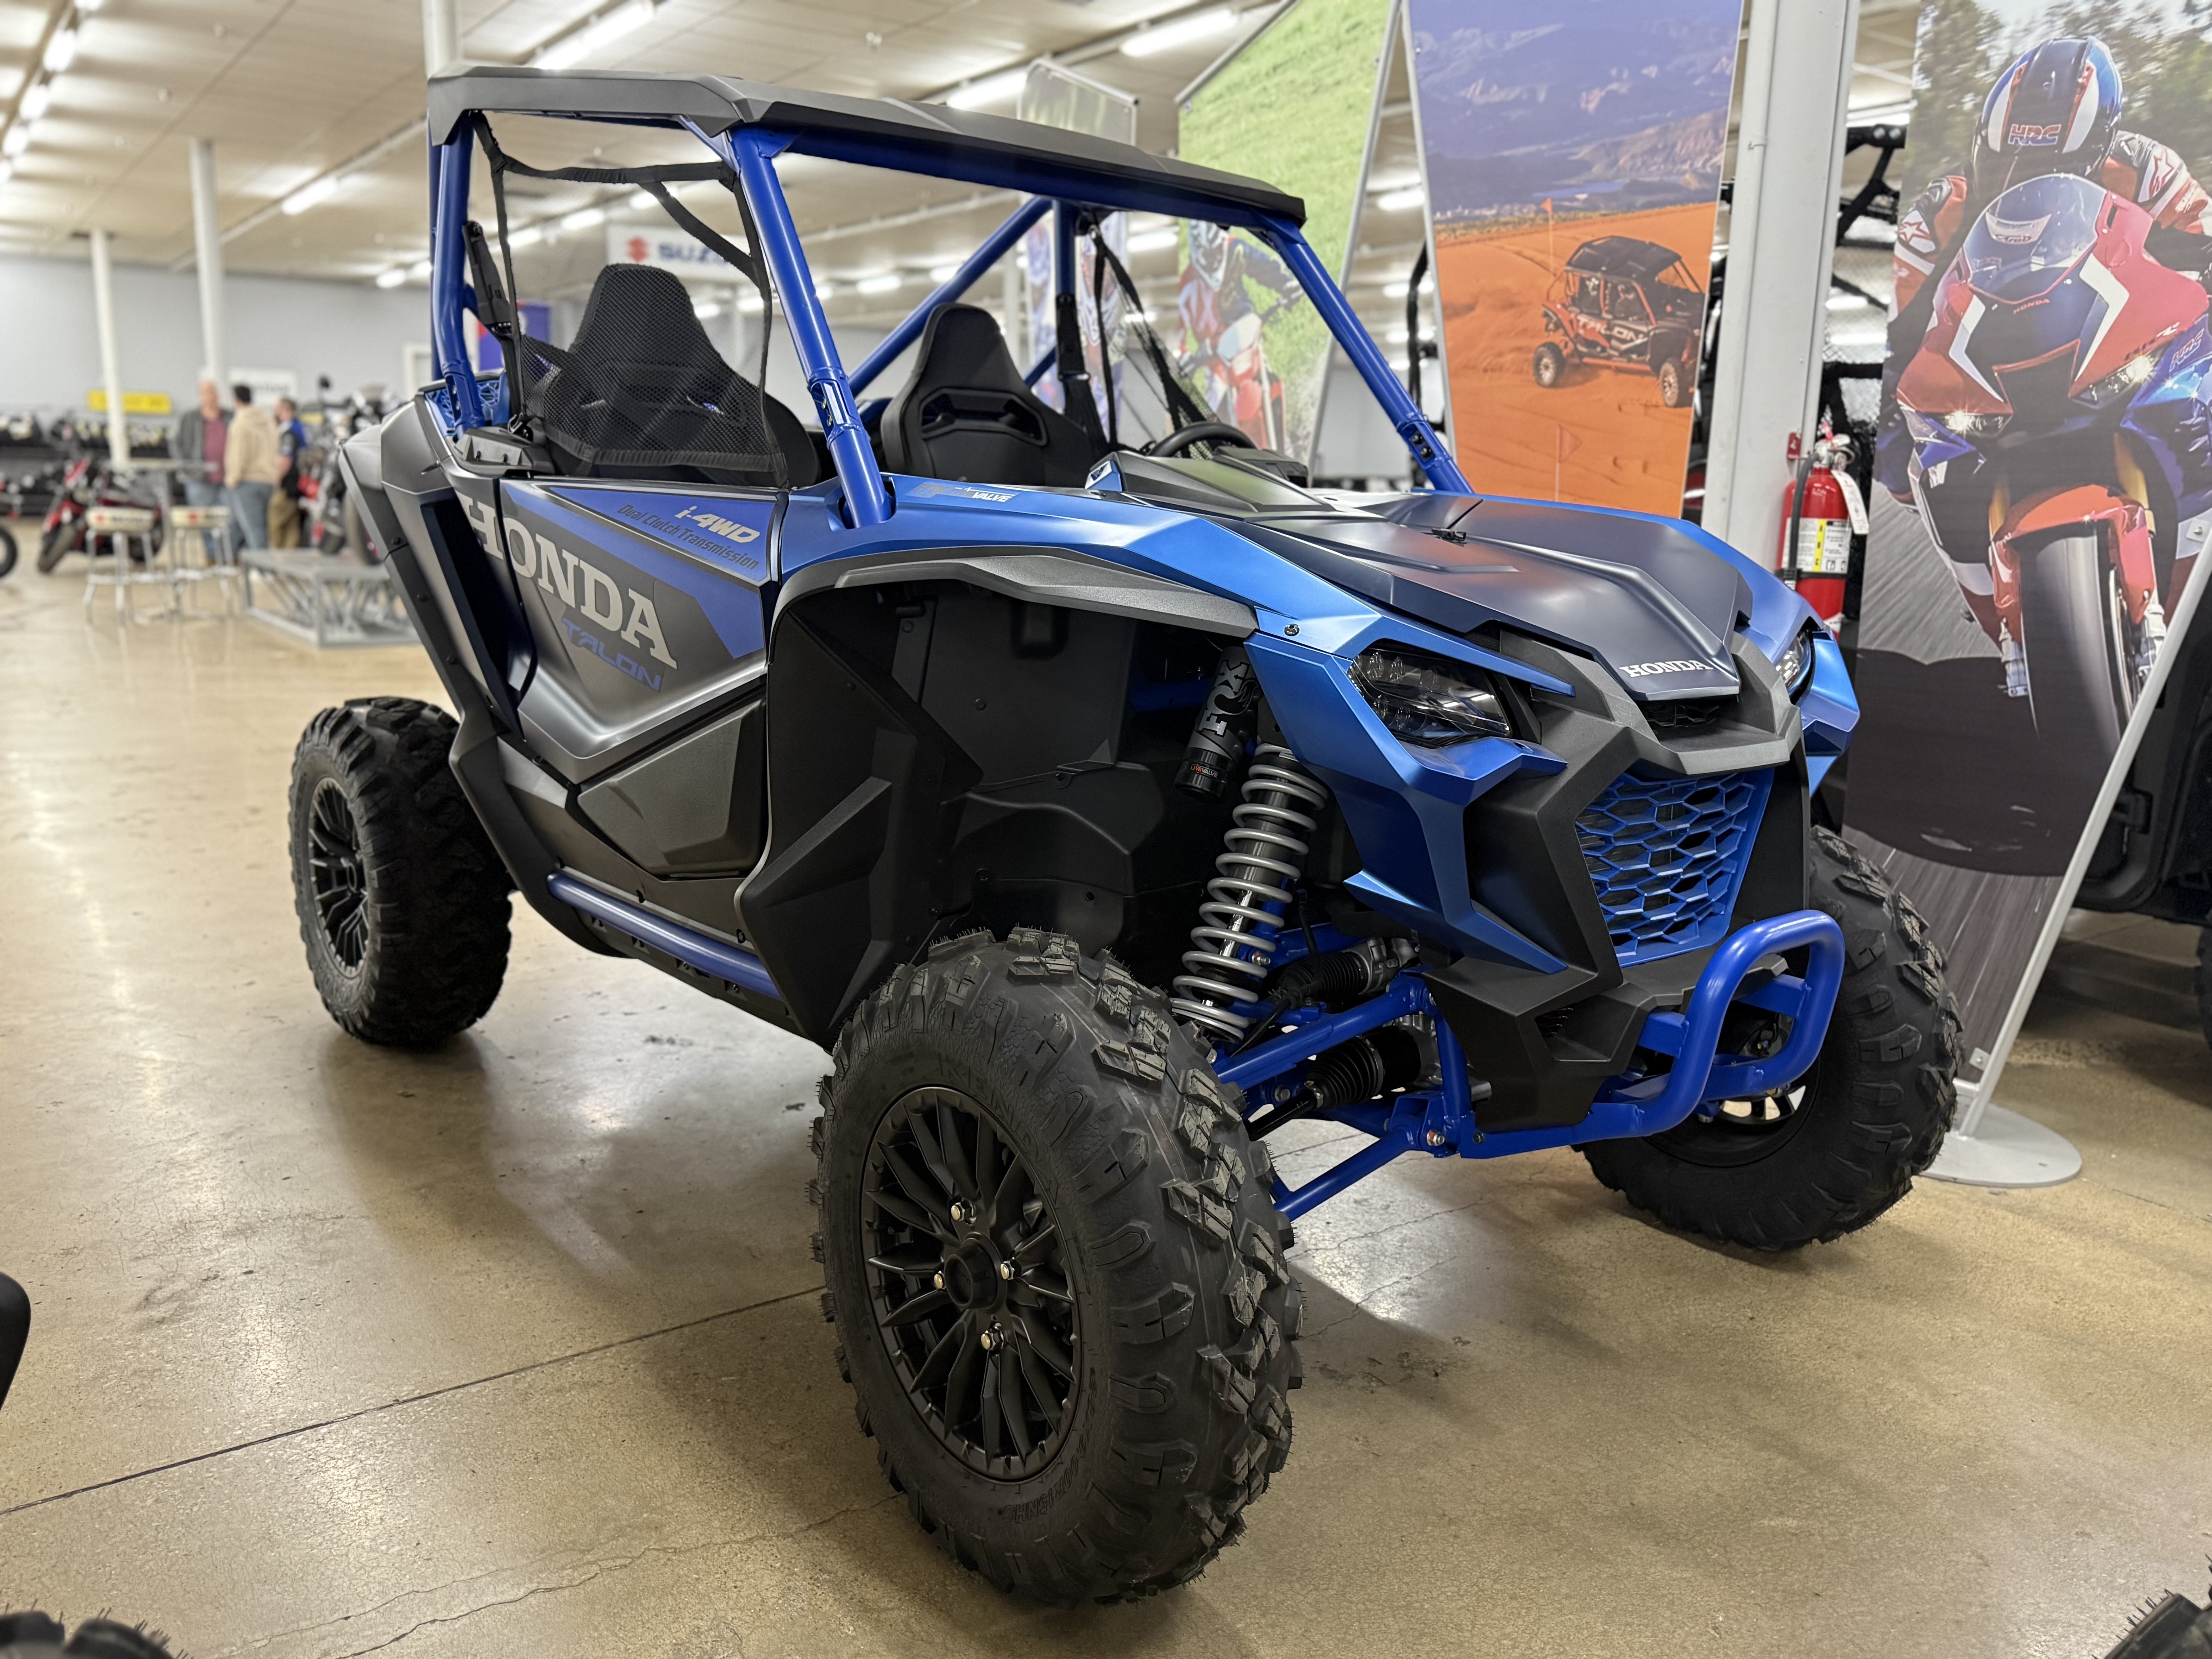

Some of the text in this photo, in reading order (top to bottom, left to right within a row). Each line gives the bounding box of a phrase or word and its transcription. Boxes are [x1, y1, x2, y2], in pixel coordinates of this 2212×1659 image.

[2008, 124, 2061, 146] HRC
[971, 491, 1012, 503] VALVE
[617, 505, 759, 570] Dual Clutch Transmission
[675, 505, 760, 543] i-4WD
[455, 491, 678, 670] HONDA
[562, 617, 661, 691] TALON
[1619, 659, 1714, 678] HONDA
[1199, 660, 1256, 736] FOX
